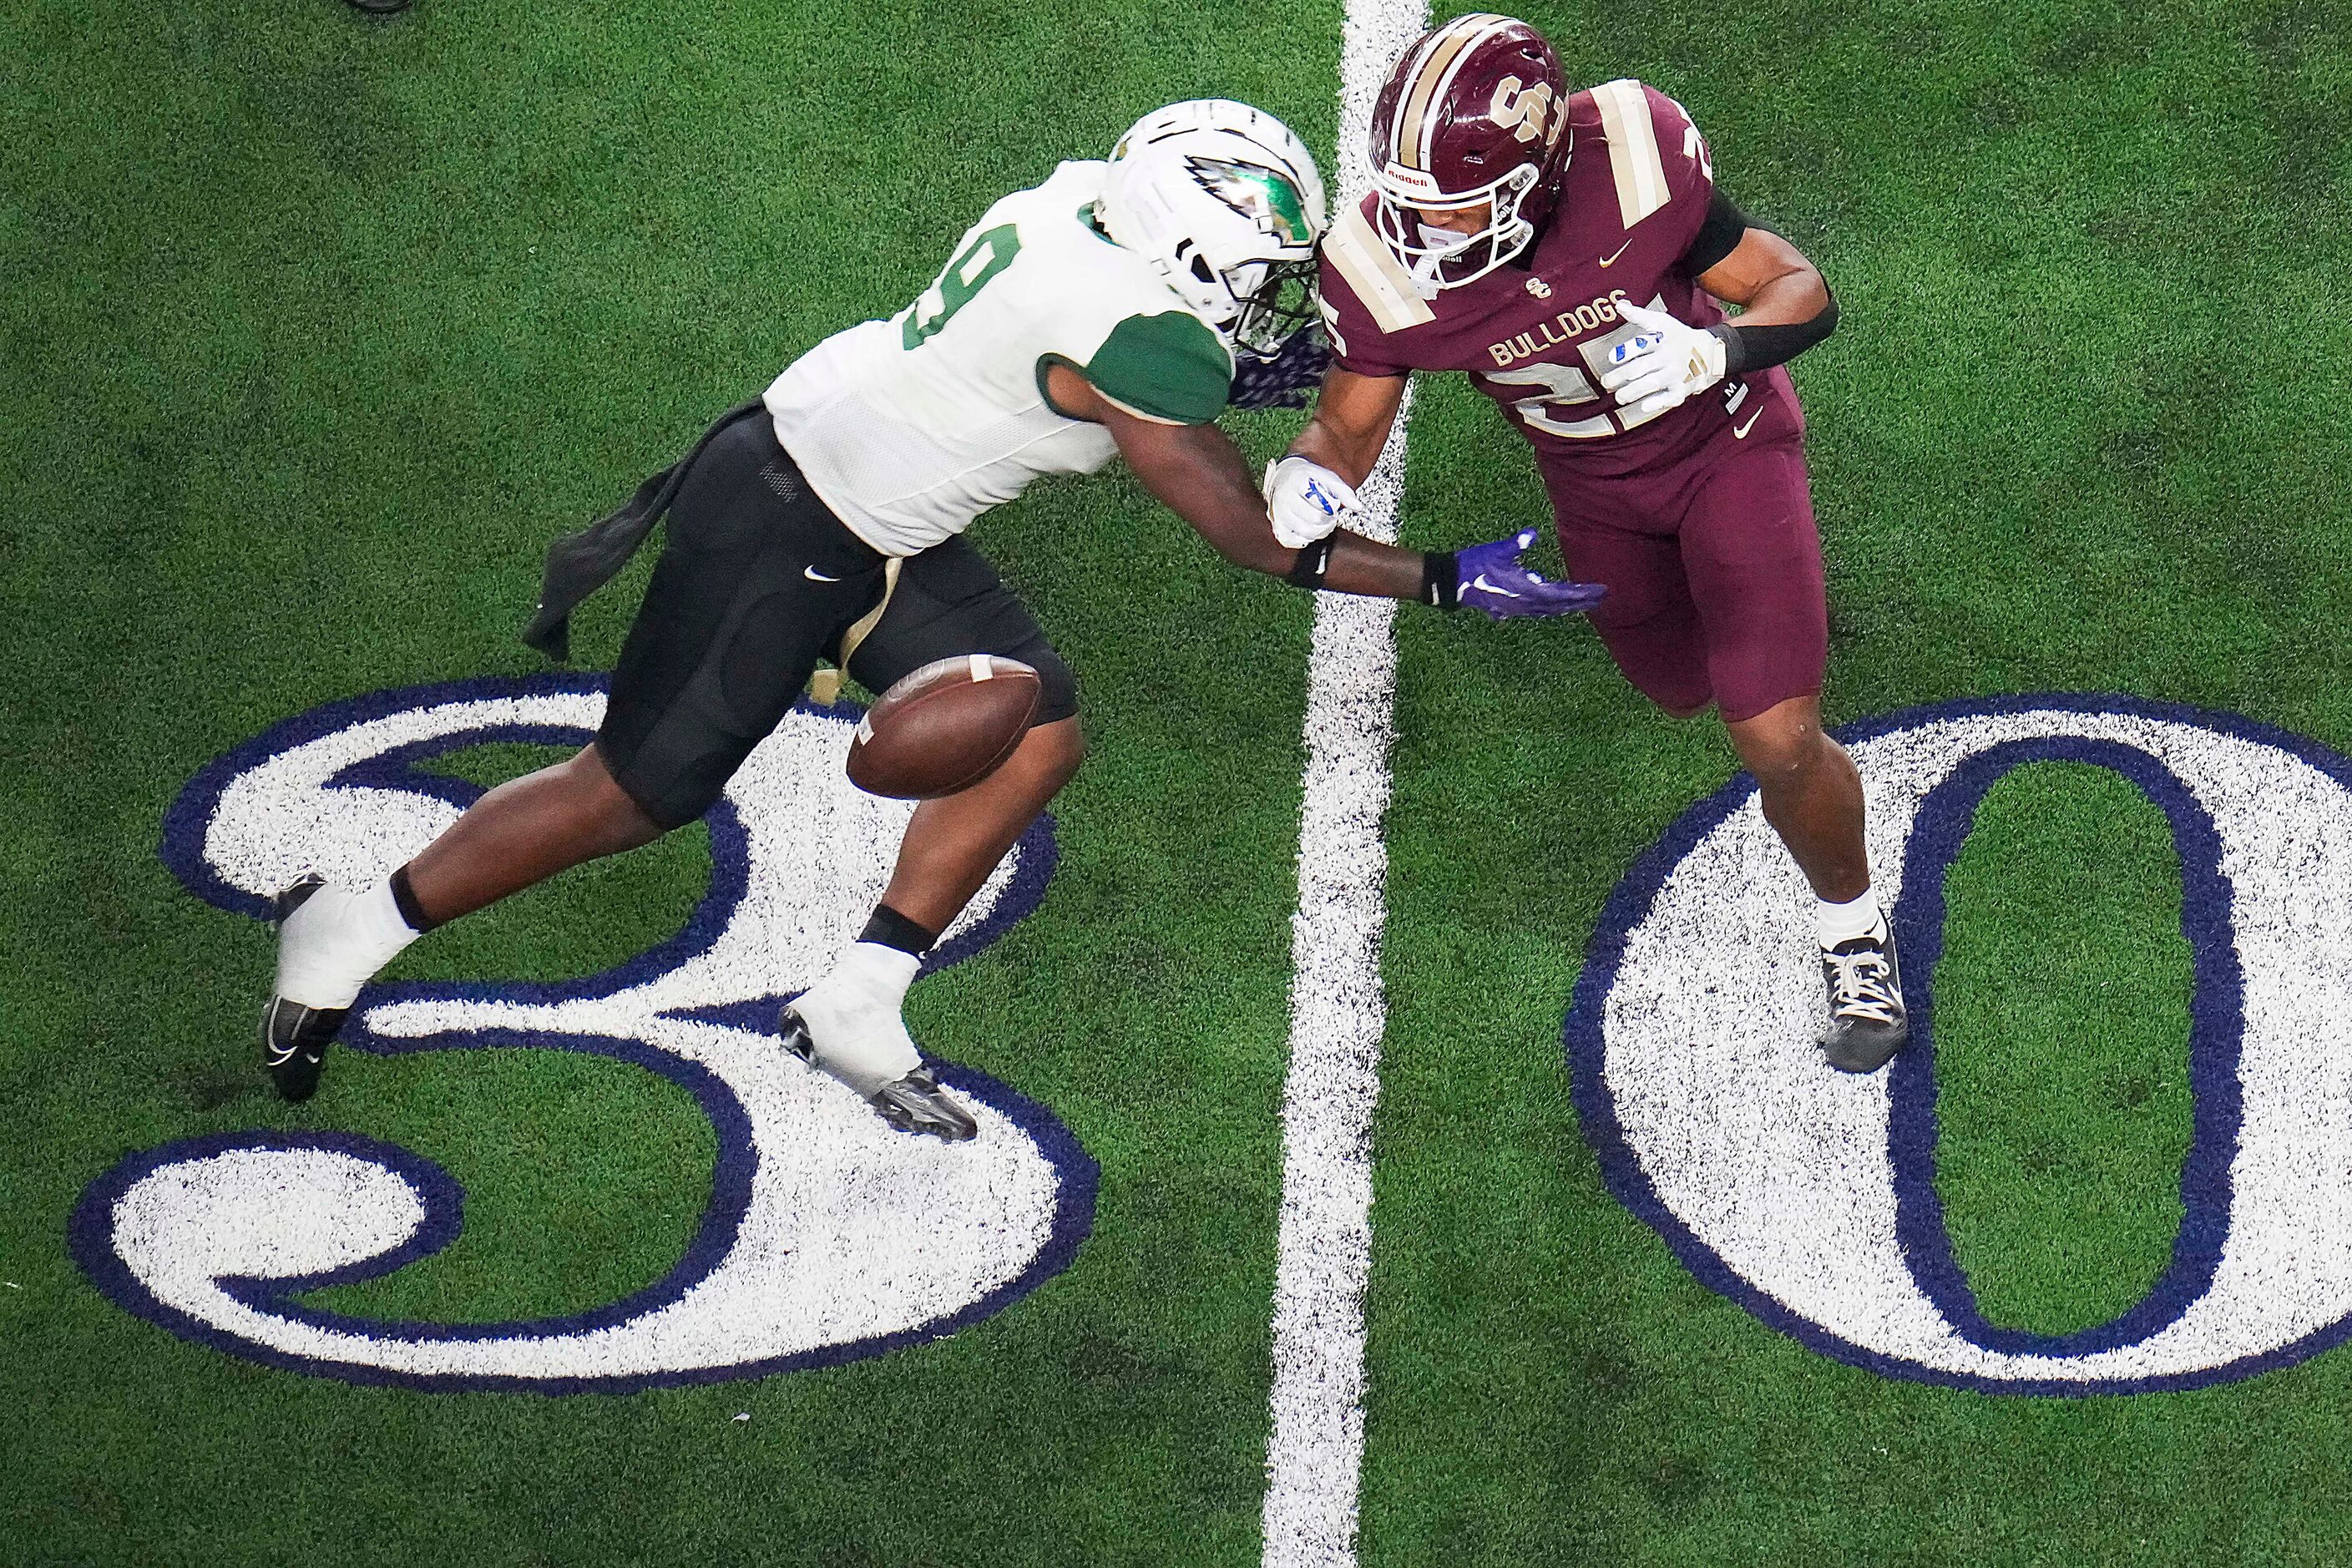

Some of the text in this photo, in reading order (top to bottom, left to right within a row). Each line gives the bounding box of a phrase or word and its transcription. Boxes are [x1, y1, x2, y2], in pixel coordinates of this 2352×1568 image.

[903, 223, 1022, 351] 9
[1525, 277, 1552, 299] SC
[1724, 382, 1737, 397] M
[68, 672, 2352, 1397] 3 0
